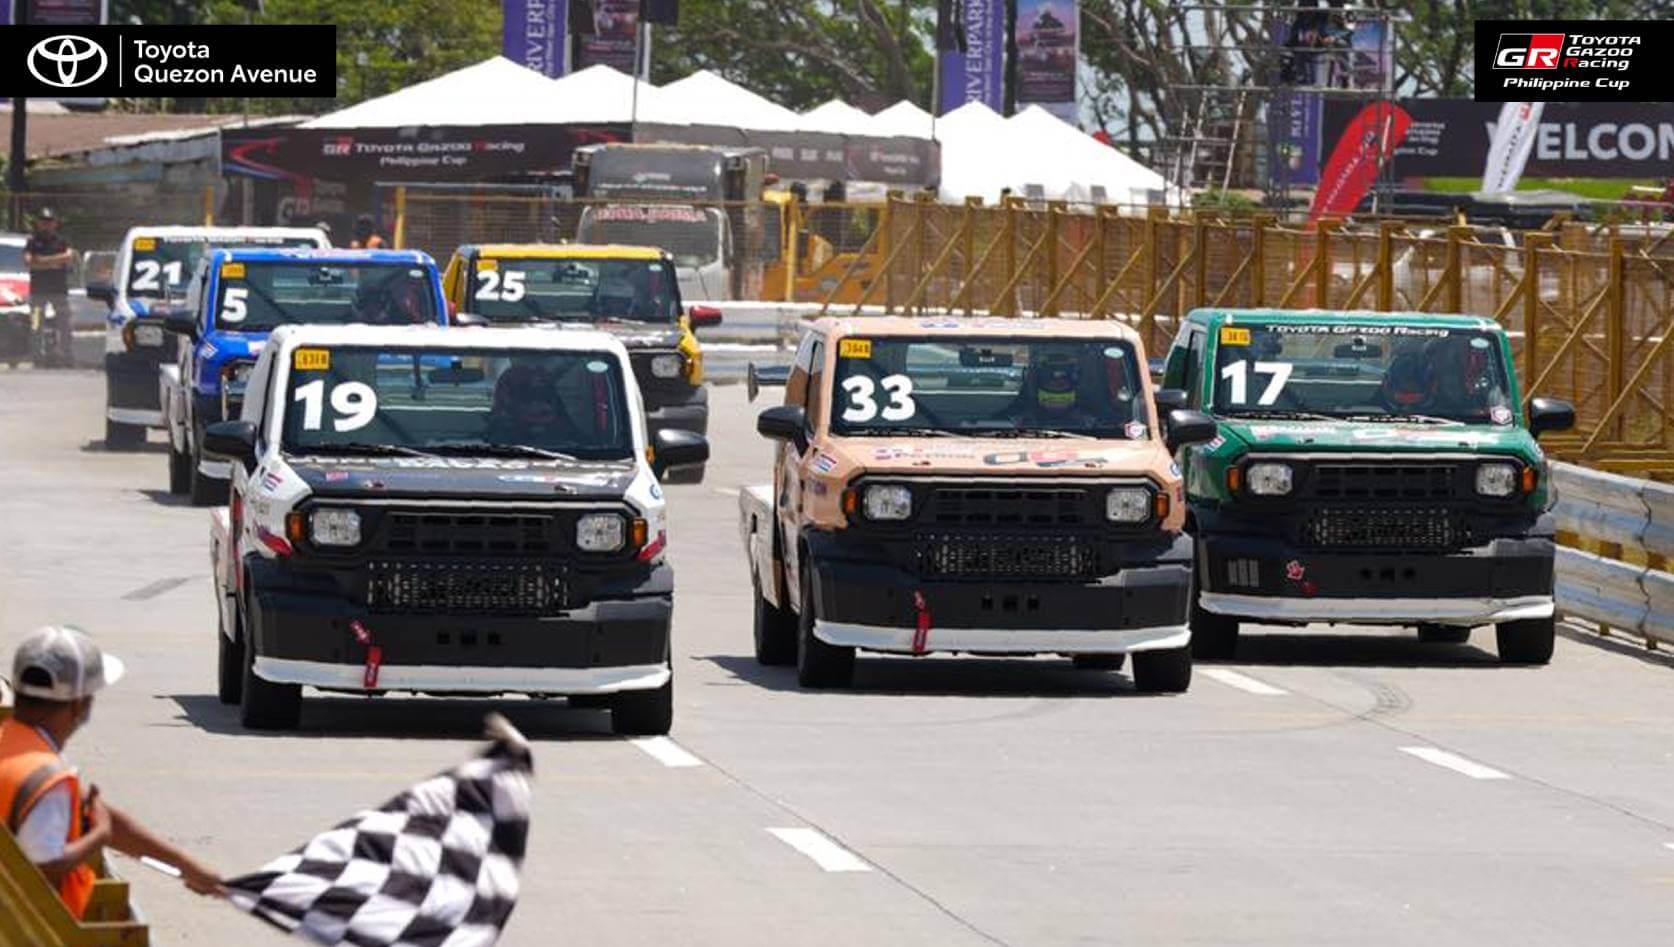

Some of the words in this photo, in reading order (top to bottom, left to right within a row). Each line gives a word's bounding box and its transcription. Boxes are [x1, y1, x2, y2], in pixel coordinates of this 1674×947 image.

[131, 260, 183, 291] 21
[475, 270, 526, 302] 25
[220, 287, 249, 322] 5
[841, 374, 916, 422] 33
[1221, 359, 1294, 406] 17
[294, 379, 378, 432] 19
